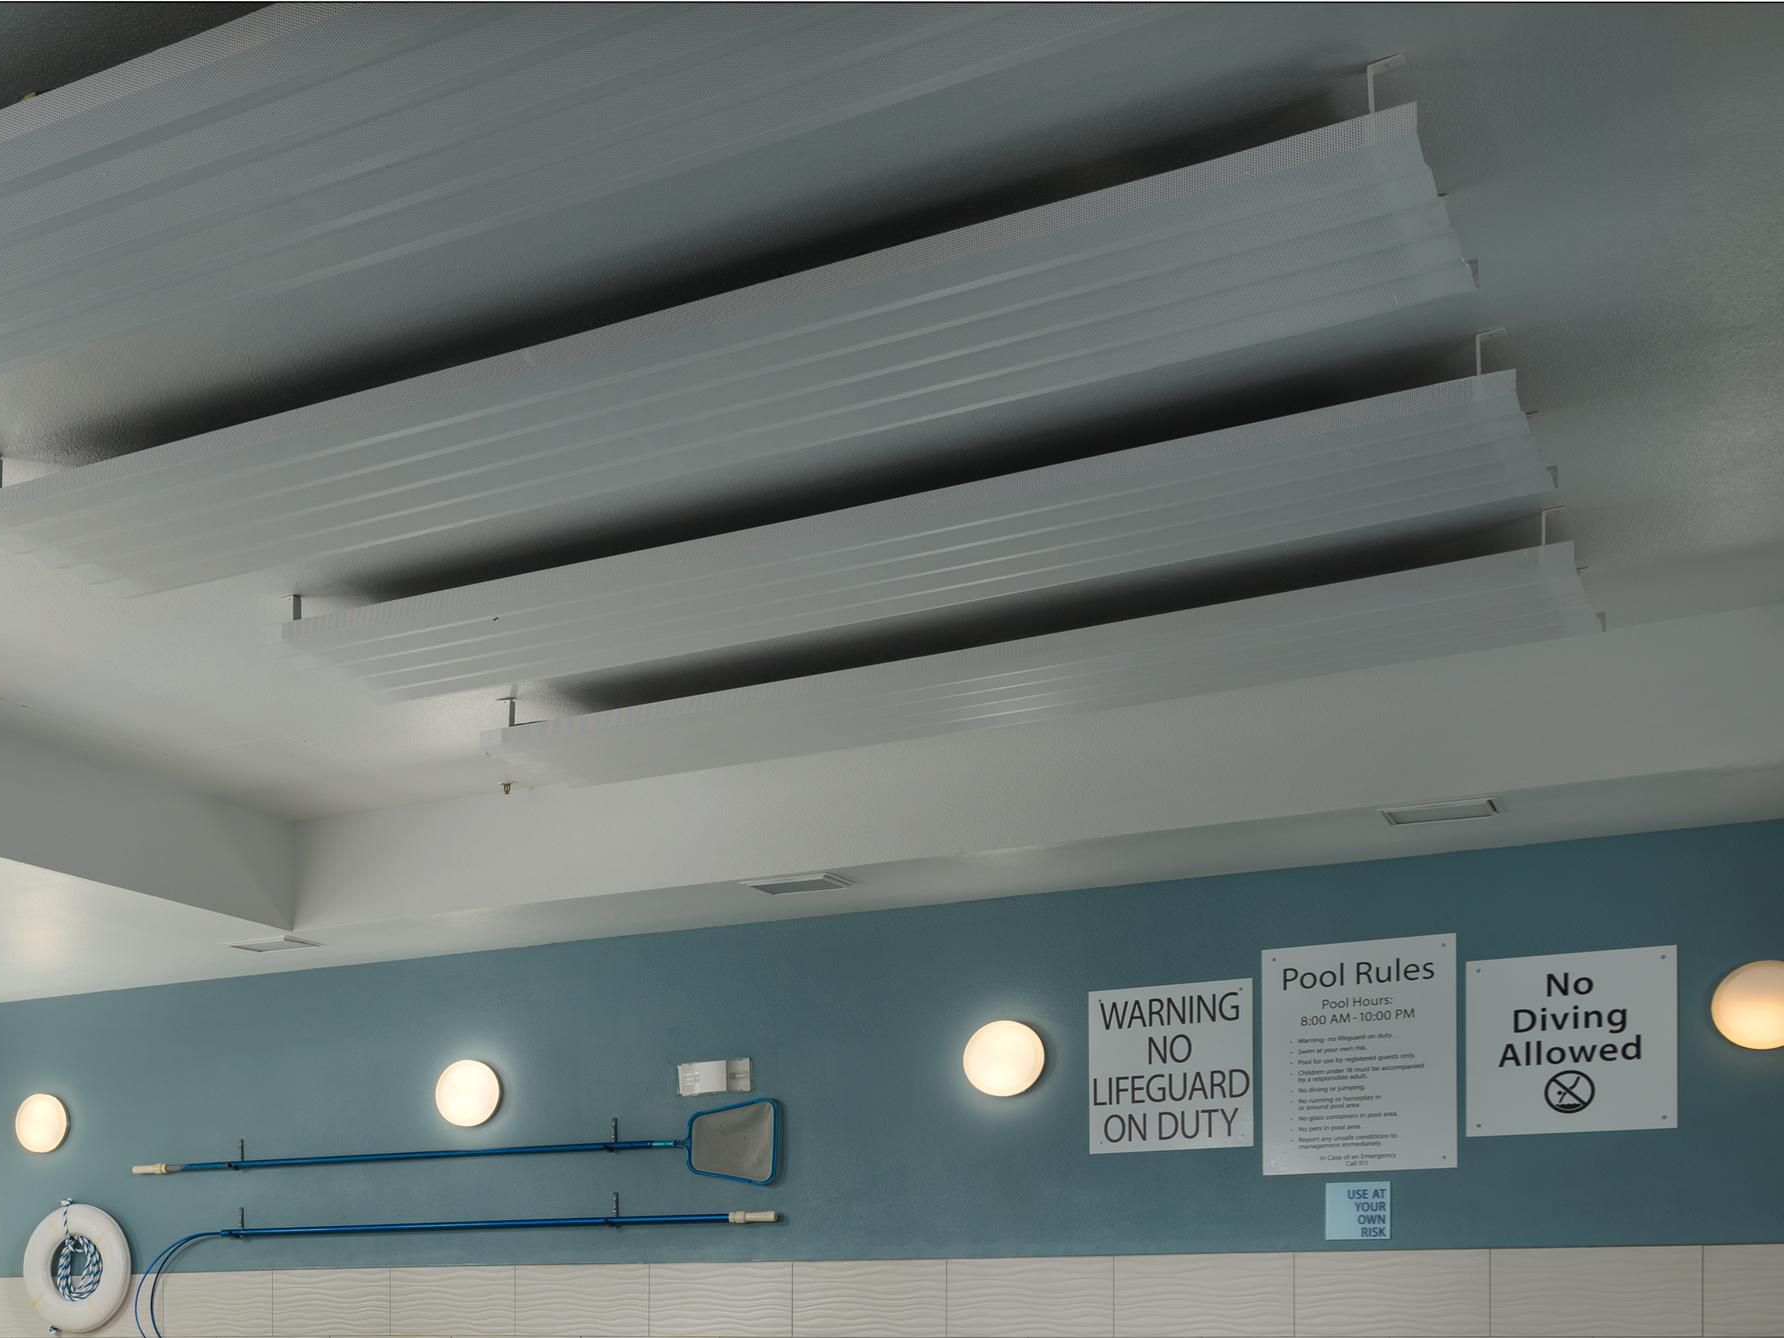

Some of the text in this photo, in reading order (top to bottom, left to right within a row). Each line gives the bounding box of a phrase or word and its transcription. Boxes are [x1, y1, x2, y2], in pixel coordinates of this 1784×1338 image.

[1283, 958, 1435, 991] Pool Rules
[1546, 972, 1594, 997] No
[1100, 992, 1240, 1030] WARNING
[1321, 995, 1393, 1009] Pool Hours:
[1300, 1015, 1326, 1027] 8:00
[1330, 1013, 1351, 1024] AM
[1395, 1008, 1416, 1020] PM
[1513, 1005, 1627, 1034] Diving
[1148, 1034, 1192, 1065] NO
[1498, 1034, 1642, 1068] Allowed
[1093, 1069, 1250, 1106] LIFEGUARD
[1104, 1107, 1239, 1143] ON DUTY
[1347, 1188, 1387, 1200] USE AT
[1355, 1201, 1387, 1212] YOUR
[1357, 1214, 1386, 1225] OWN
[1361, 1226, 1387, 1238] RISK
